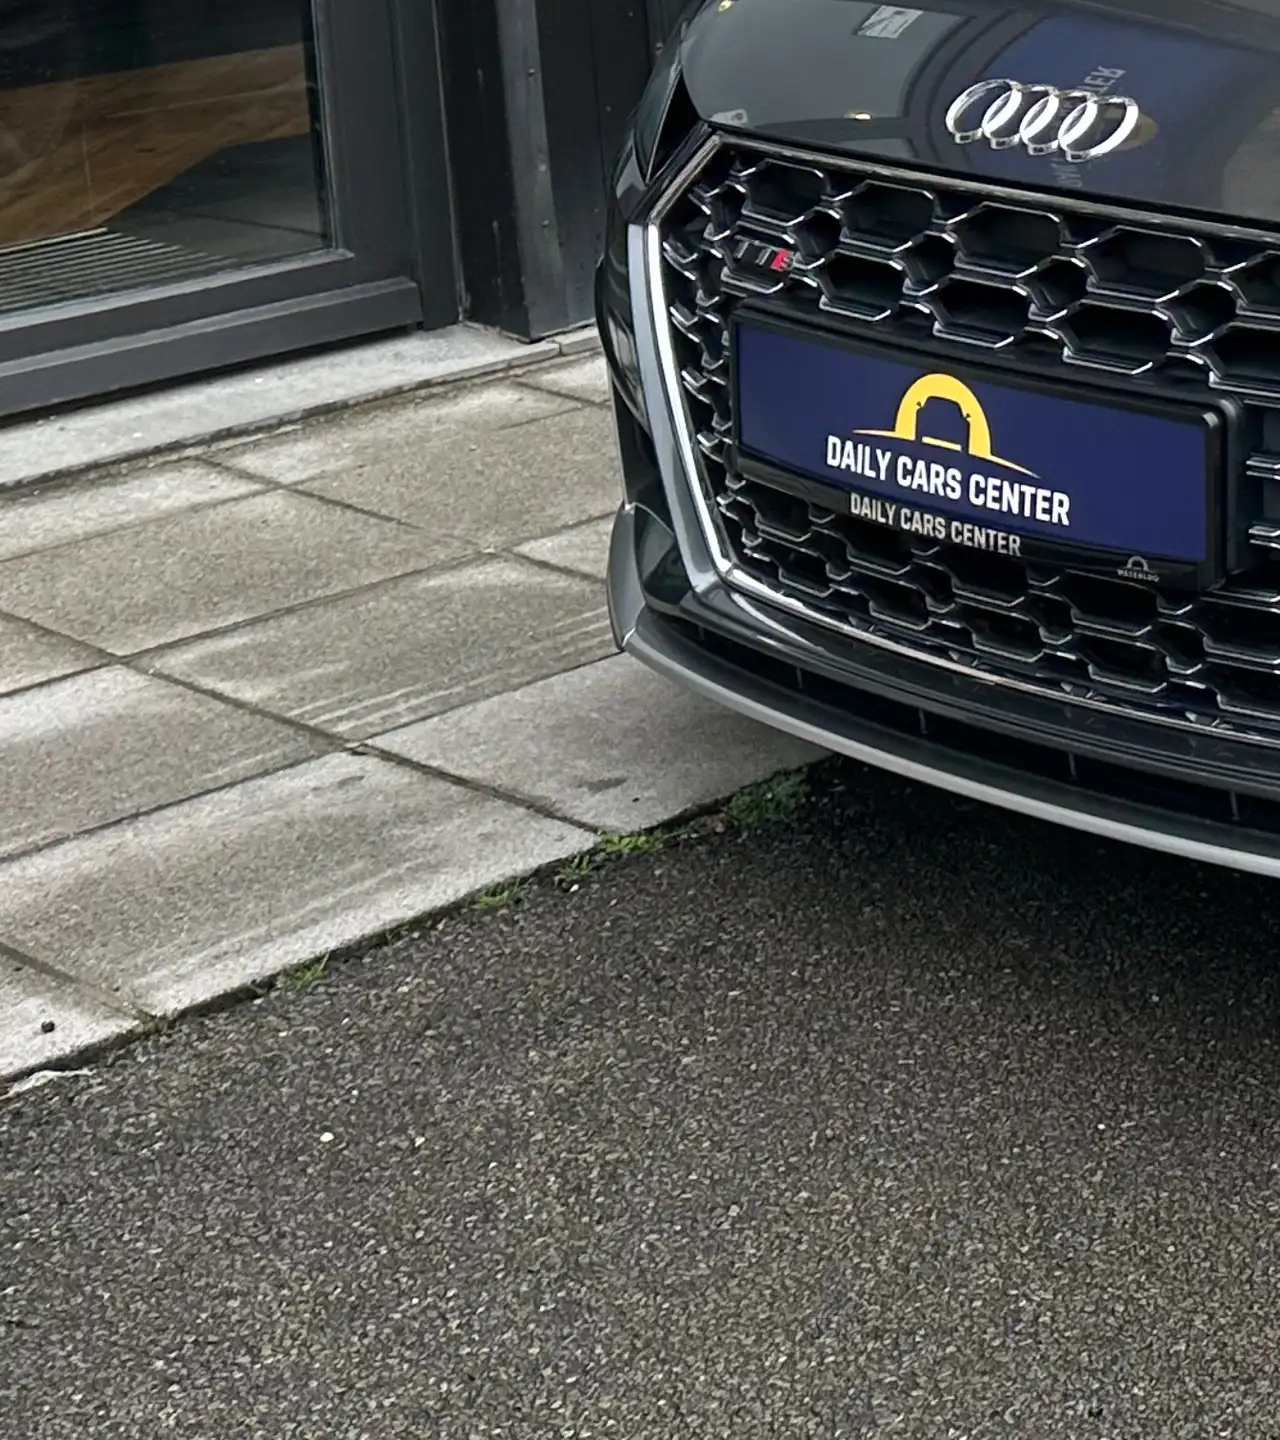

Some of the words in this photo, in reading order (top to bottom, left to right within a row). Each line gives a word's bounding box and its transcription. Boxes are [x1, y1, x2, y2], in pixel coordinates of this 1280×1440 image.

[826, 434, 892, 481] DAILY
[896, 455, 962, 500] CARS
[968, 473, 1071, 526] CENTER
[850, 492, 897, 527] DAILY
[900, 507, 947, 540] CARS
[951, 520, 1022, 557] CENTER
